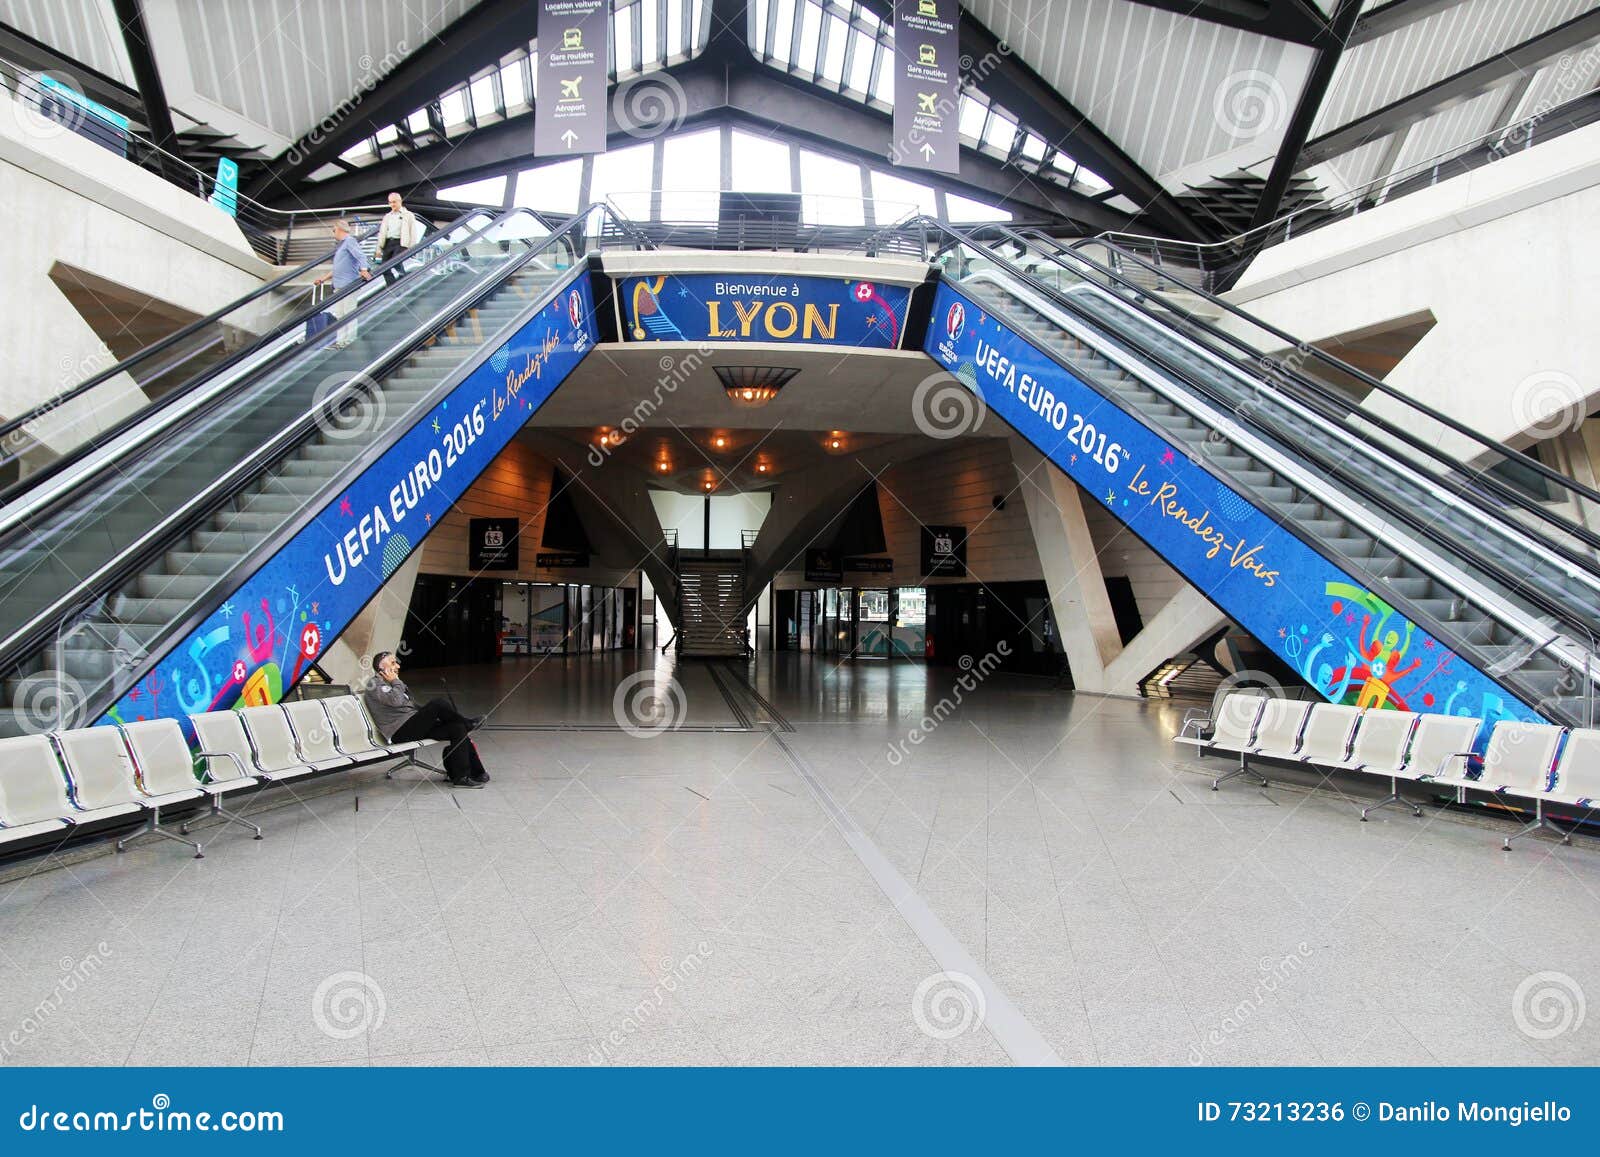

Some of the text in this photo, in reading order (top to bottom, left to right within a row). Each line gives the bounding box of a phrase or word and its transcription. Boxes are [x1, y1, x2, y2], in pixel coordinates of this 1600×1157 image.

[545, 0, 602, 11] Location voitures
[901, 13, 928, 26] Location
[928, 19, 954, 31] voitures
[550, 51, 594, 61] Gare routière
[907, 64, 922, 74] Gare
[922, 66, 948, 79] routière
[555, 103, 585, 113] Aéroport
[715, 282, 799, 297] Bienvenue à
[706, 300, 840, 340] LYON
[324, 505, 390, 586] UEFA
[389, 448, 443, 523] EURO
[493, 387, 506, 421] Le
[506, 326, 560, 406] Rendez-Vous
[975, 339, 1016, 396] UEFA
[1017, 373, 1068, 431] EURO
[1128, 464, 1151, 495] Le
[1151, 481, 1280, 588] Rendez-Vous
